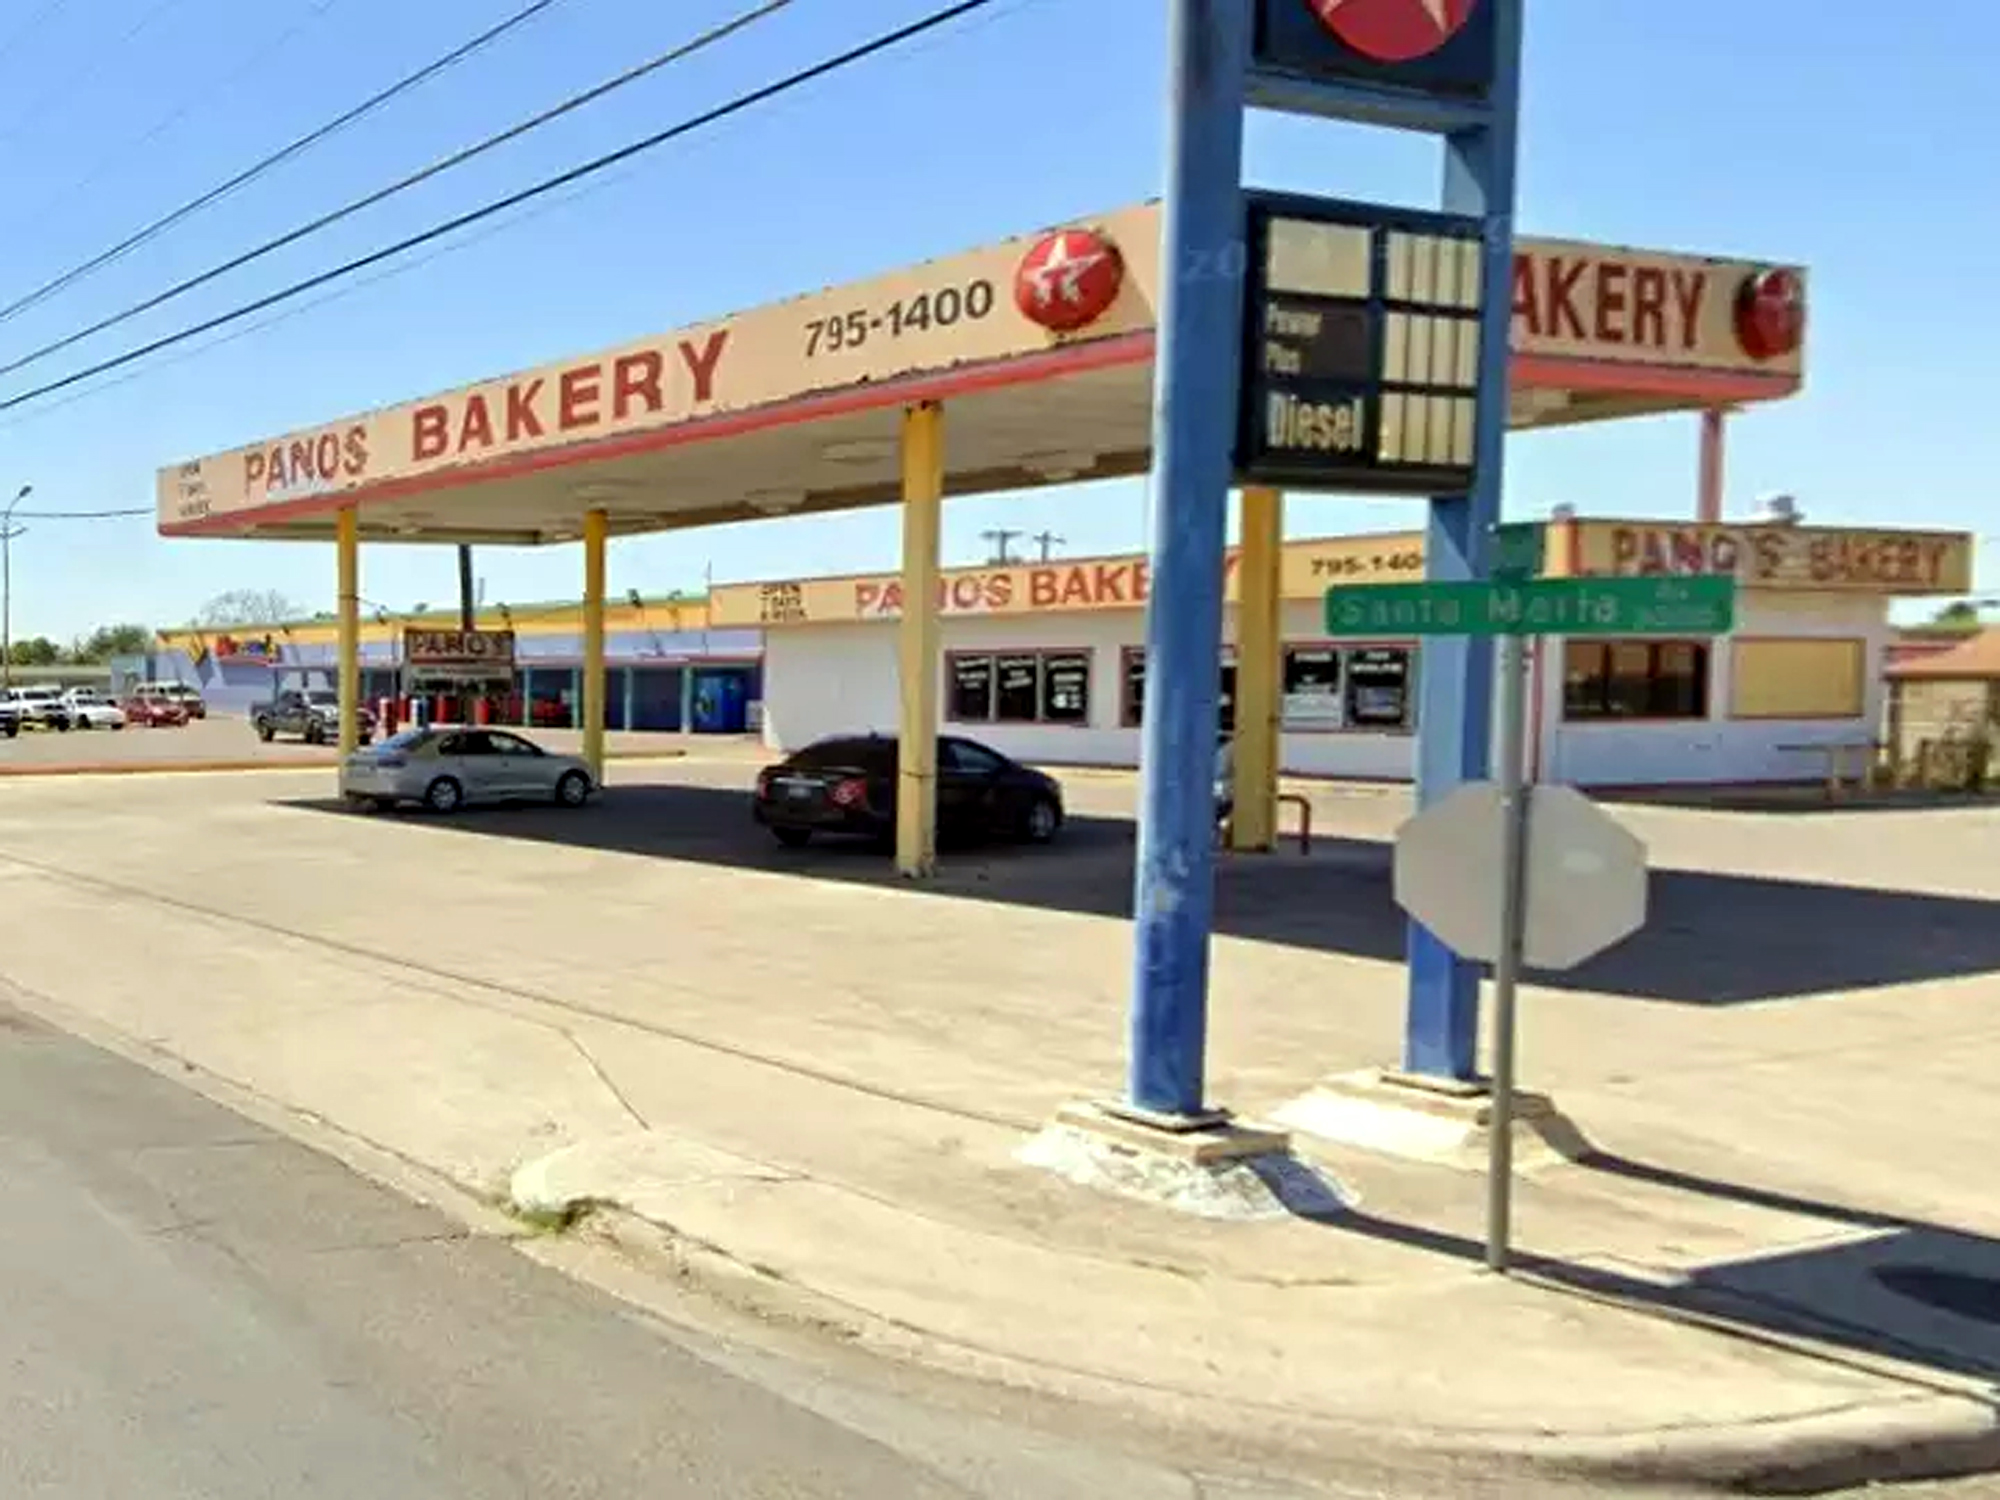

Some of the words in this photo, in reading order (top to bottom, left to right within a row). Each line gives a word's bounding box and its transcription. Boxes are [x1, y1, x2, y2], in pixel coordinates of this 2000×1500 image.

[804, 279, 994, 357] 795-1400
[1511, 253, 1705, 349] AKERY
[411, 330, 729, 461] BAKERY
[1267, 390, 1364, 450] Diesel
[1311, 553, 1424, 575] 795-140
[1338, 597, 1461, 626] Santa
